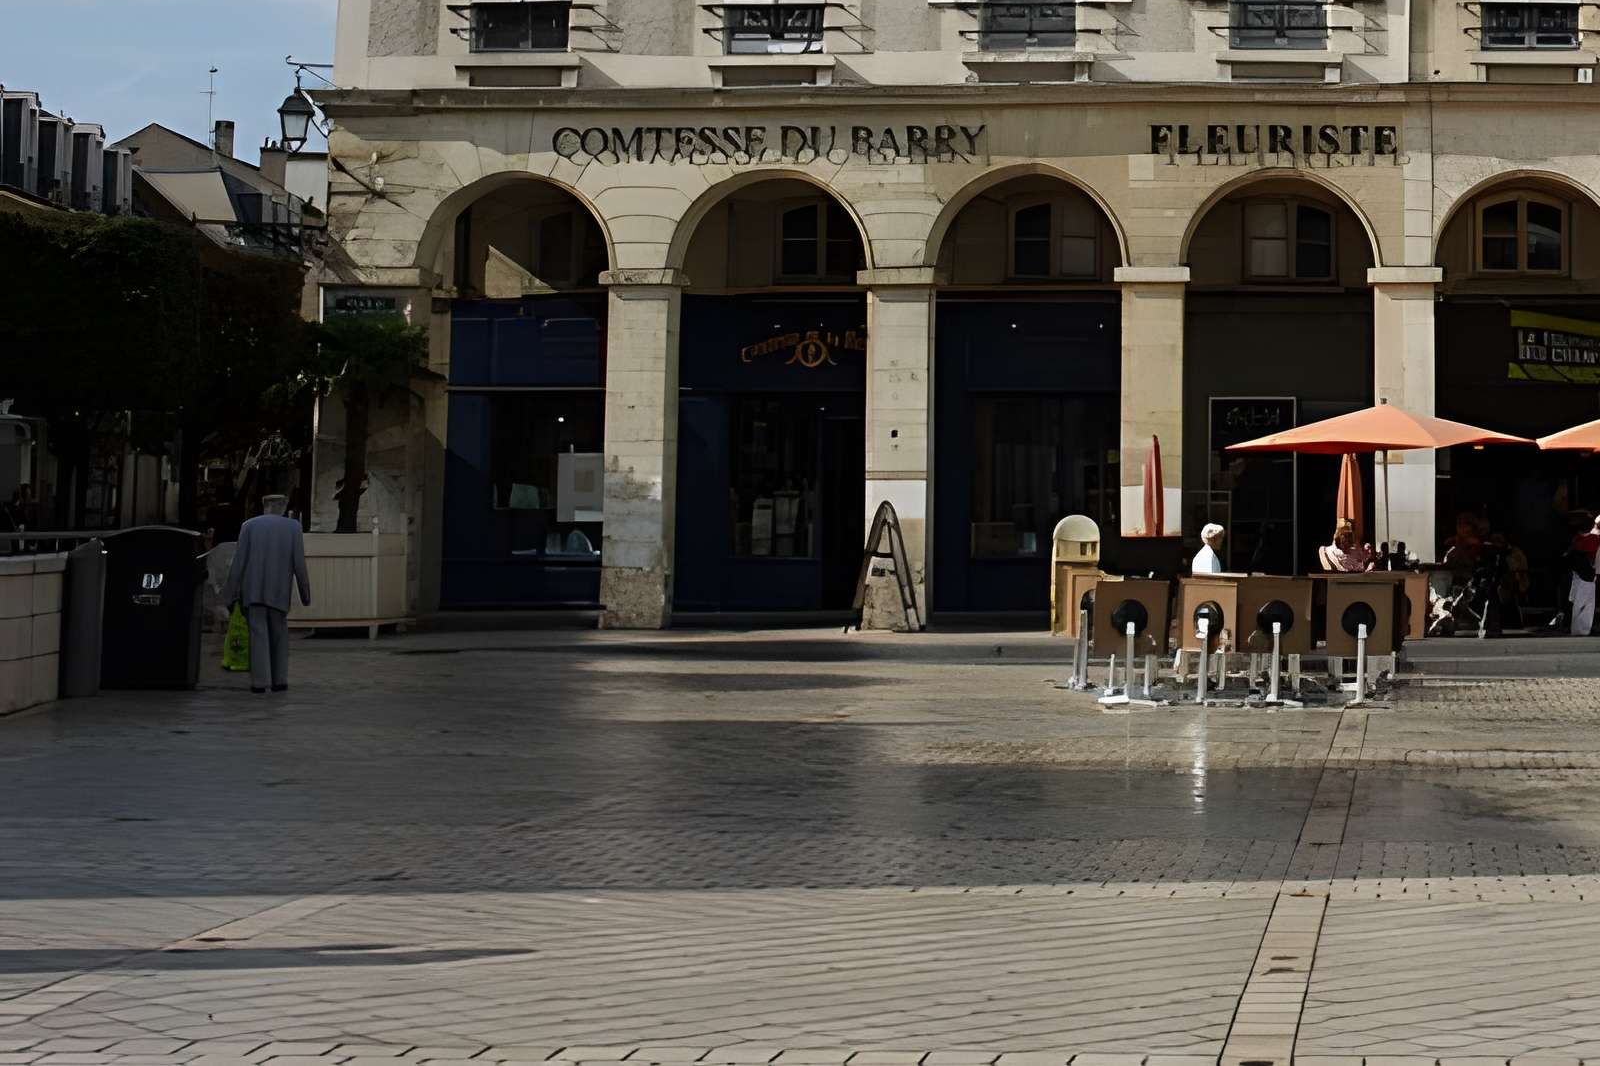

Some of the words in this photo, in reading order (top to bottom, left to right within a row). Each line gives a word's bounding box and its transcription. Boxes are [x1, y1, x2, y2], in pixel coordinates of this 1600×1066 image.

[552, 126, 768, 162] COMTESSE
[780, 126, 836, 161] DU
[850, 124, 987, 162] BARRY
[1150, 124, 1398, 156] FLEURISTE
